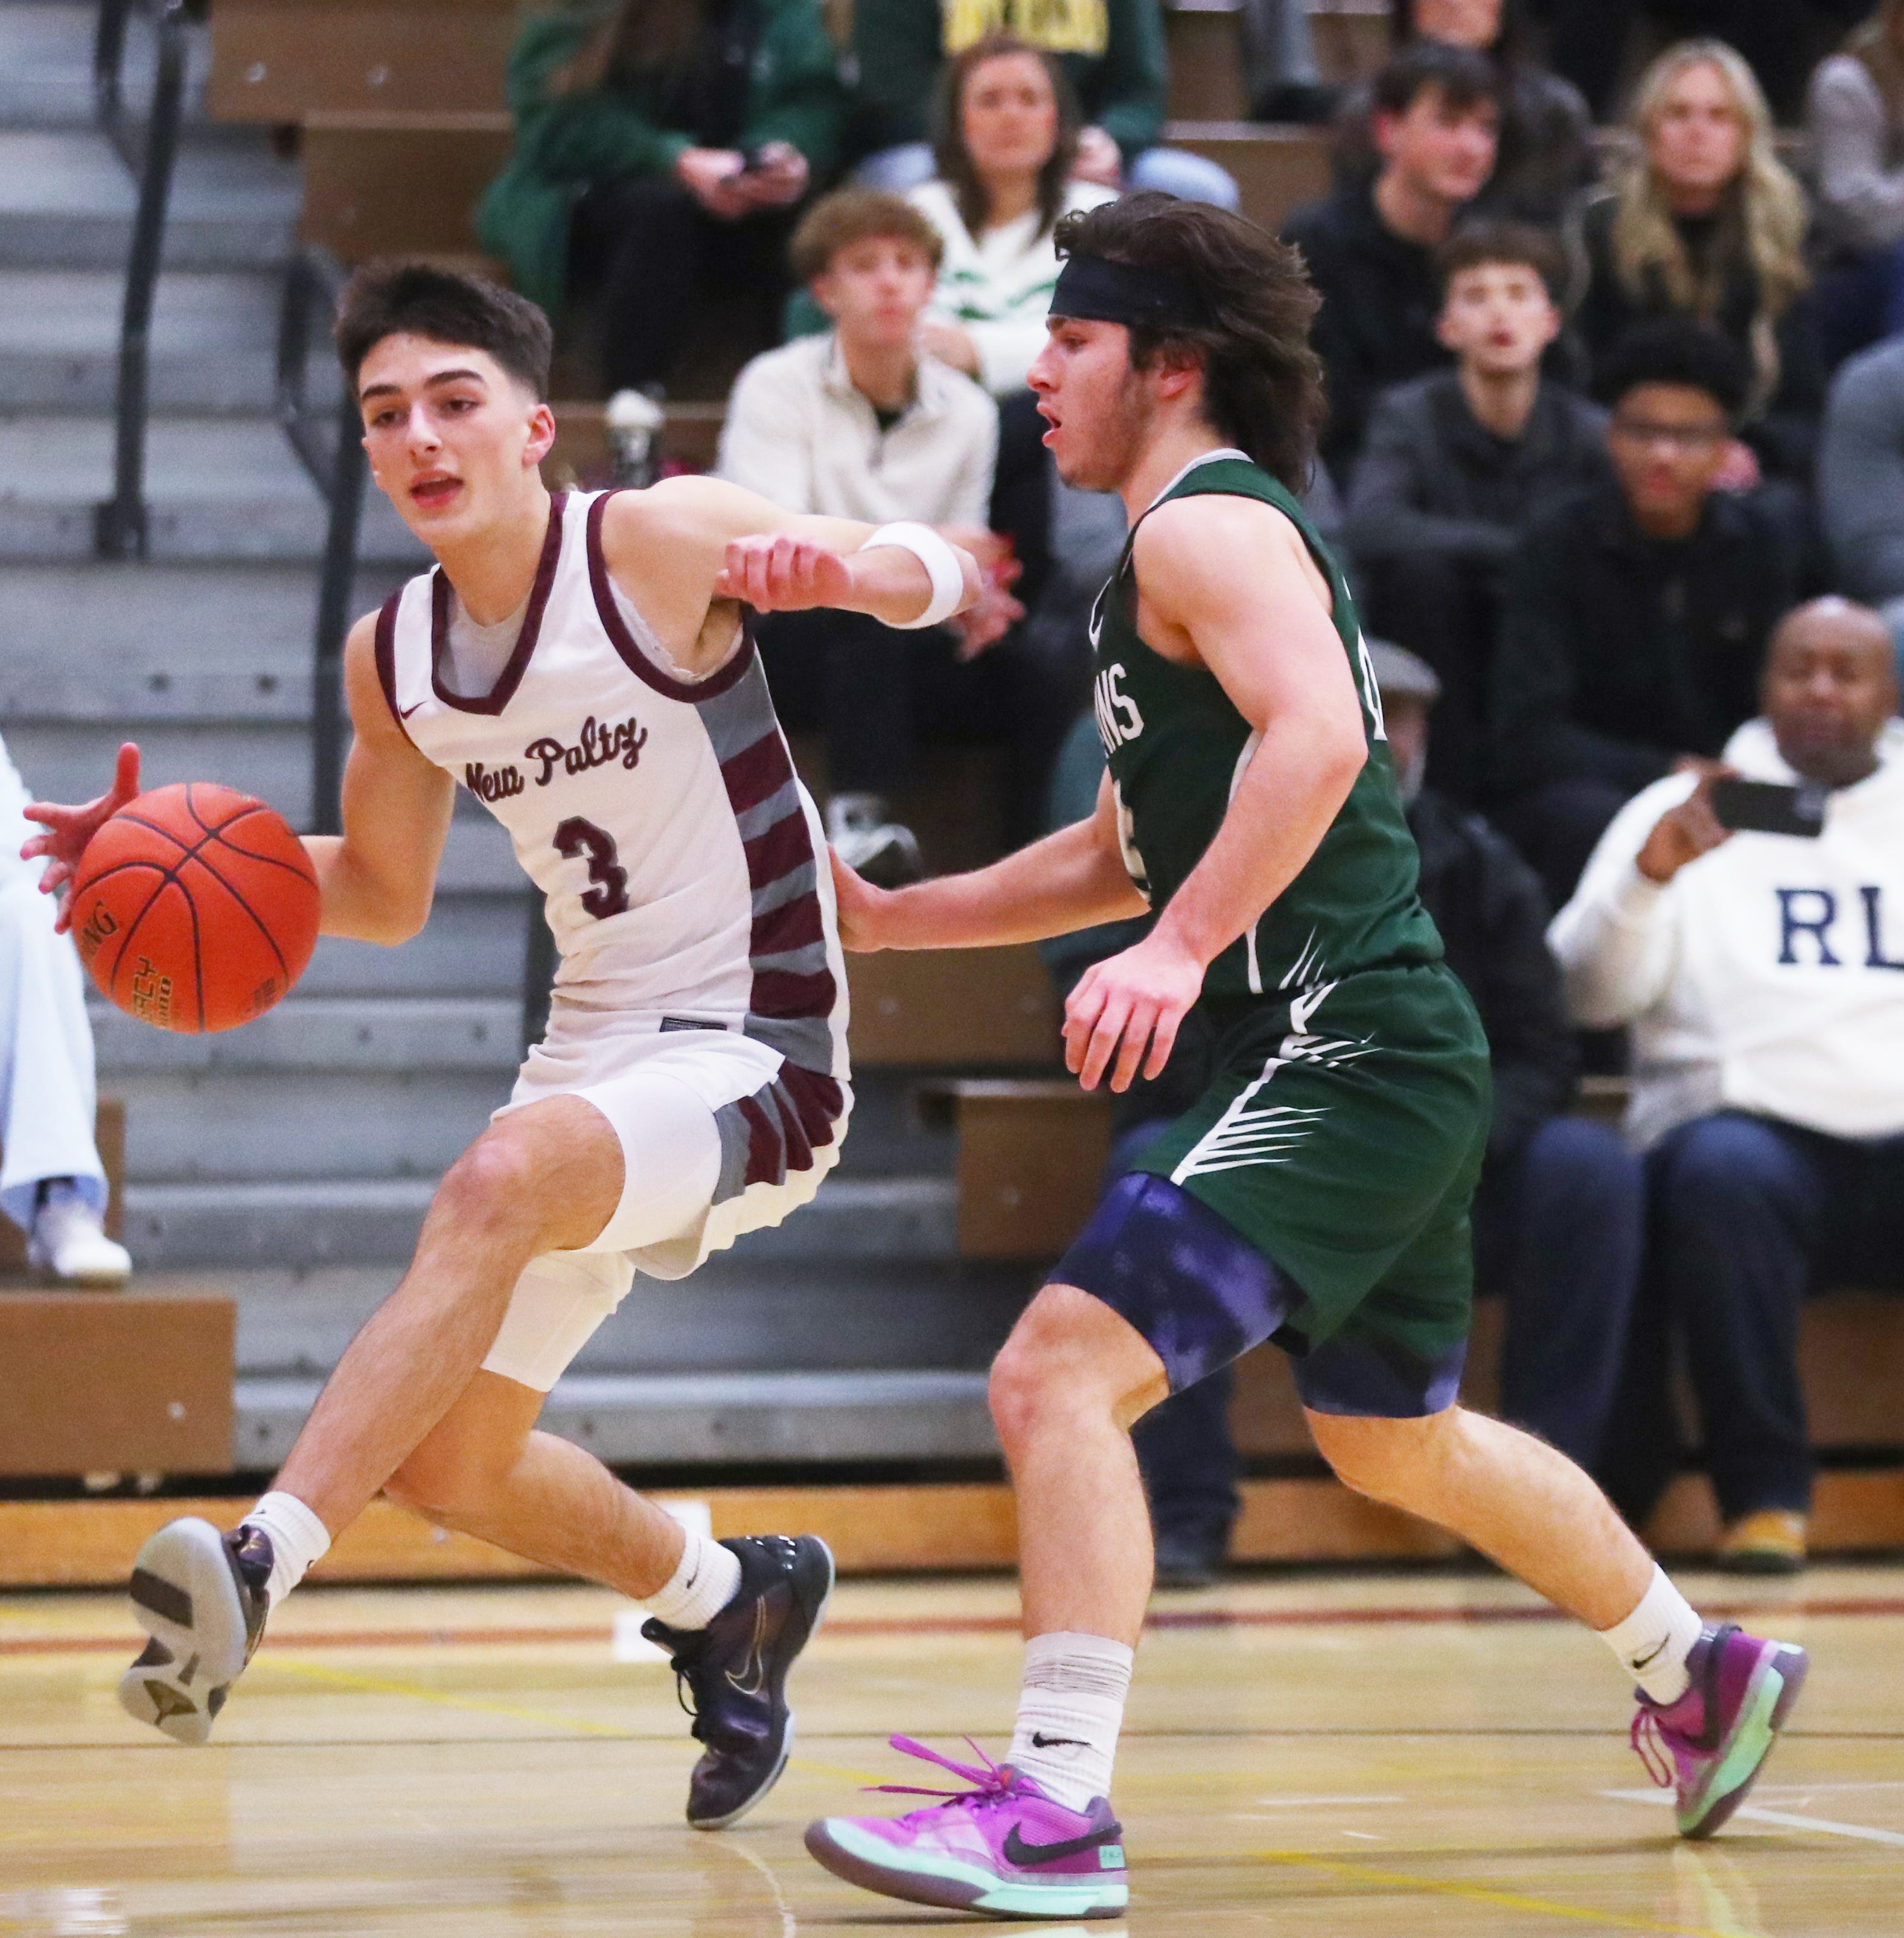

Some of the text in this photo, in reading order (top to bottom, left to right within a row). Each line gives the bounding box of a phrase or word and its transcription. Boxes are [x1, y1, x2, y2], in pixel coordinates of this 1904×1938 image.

[465, 716, 648, 802] New Paltz
[553, 816, 630, 919] 3
